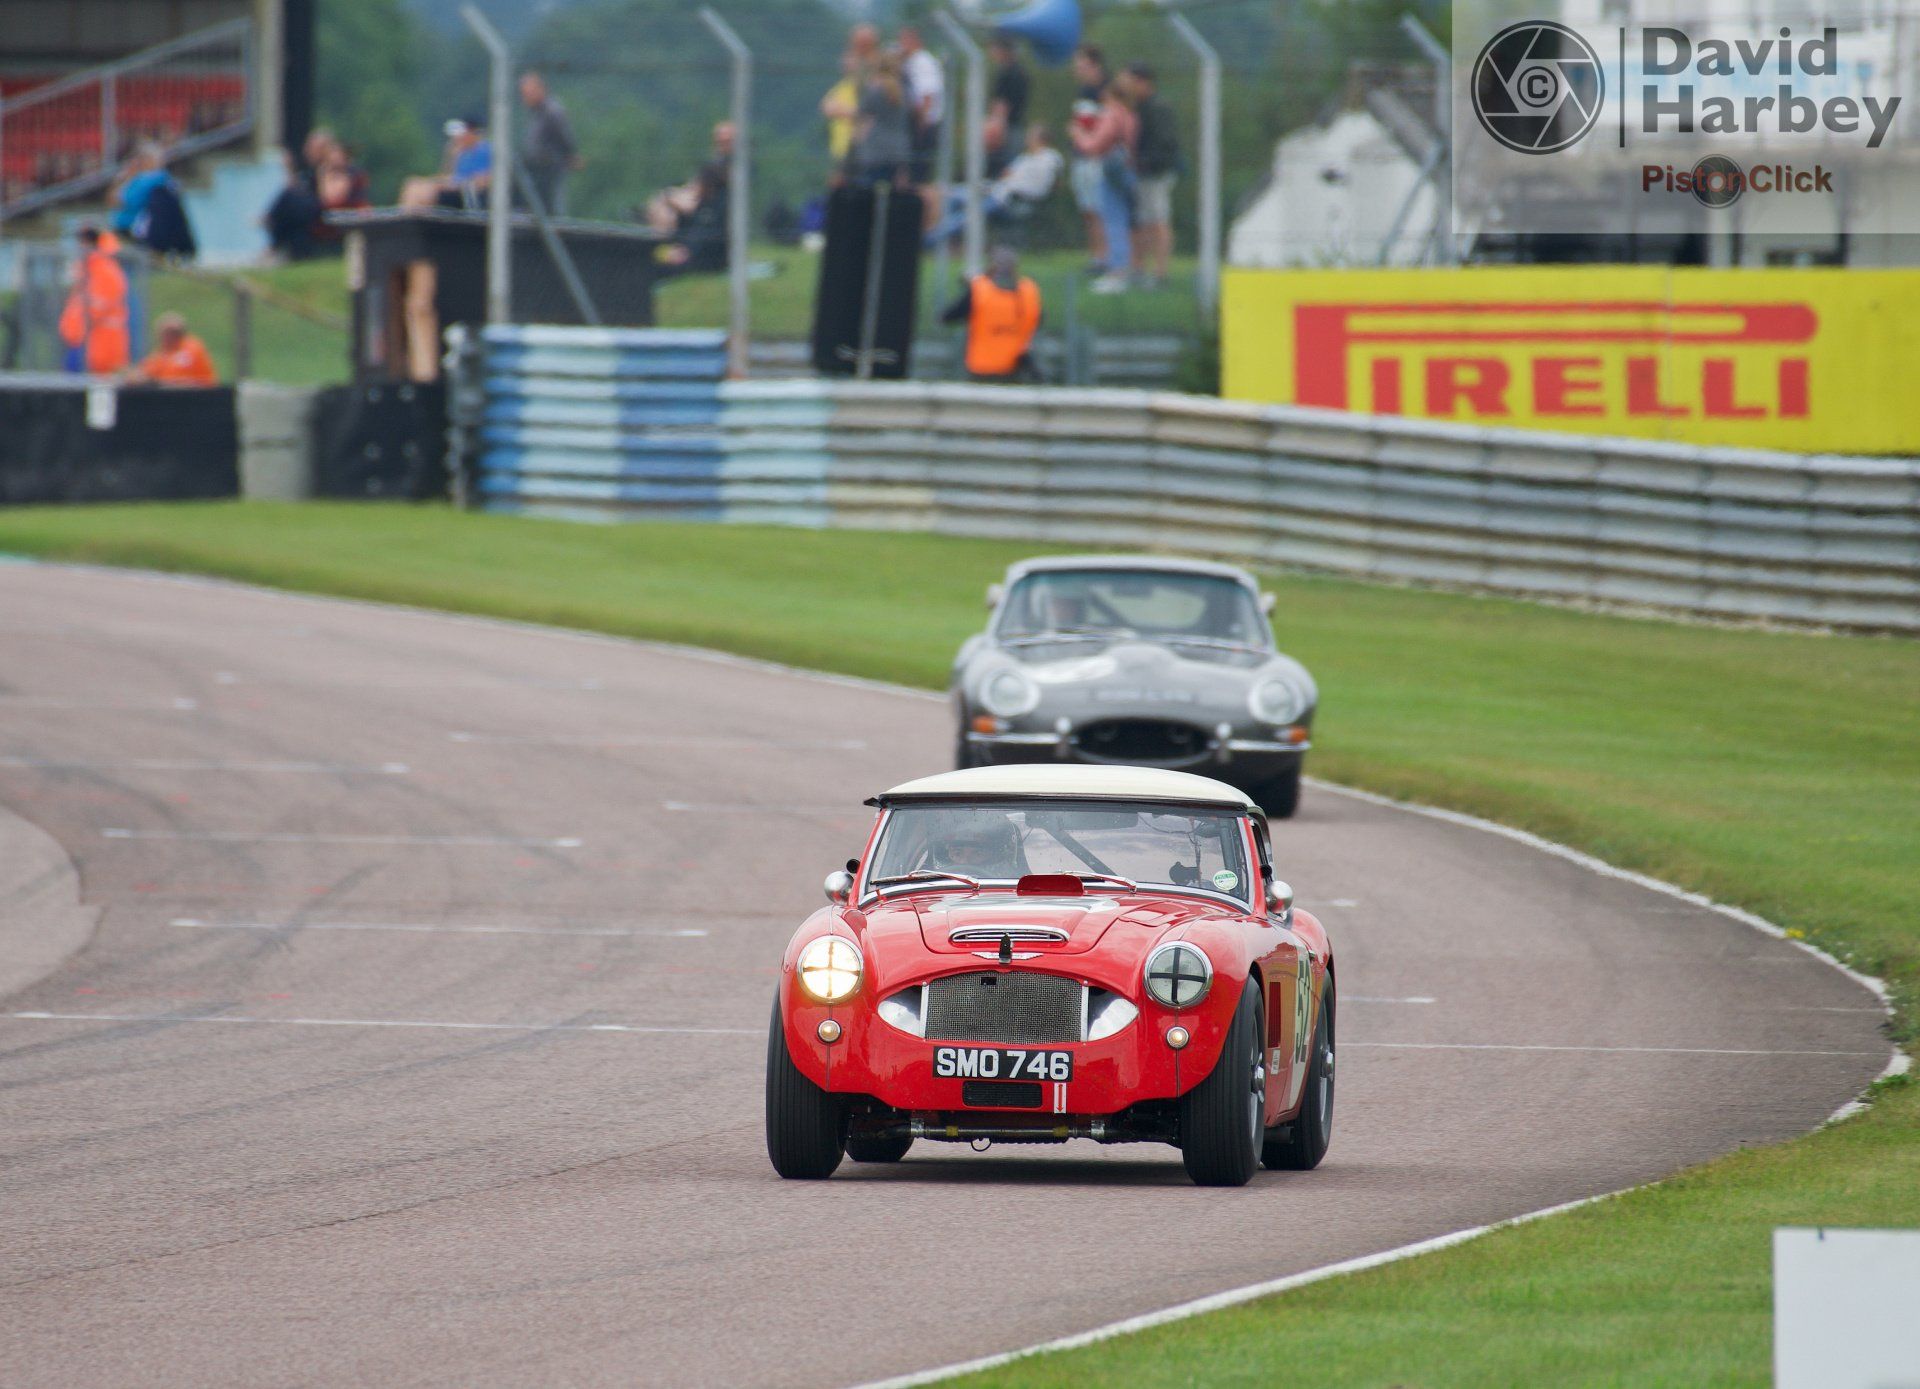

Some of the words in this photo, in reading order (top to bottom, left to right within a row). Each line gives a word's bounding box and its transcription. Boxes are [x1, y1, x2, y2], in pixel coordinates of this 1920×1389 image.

[1294, 303, 1818, 418] PIRELLI
[937, 1048, 999, 1077] SMO
[1006, 1051, 1070, 1080] 746
